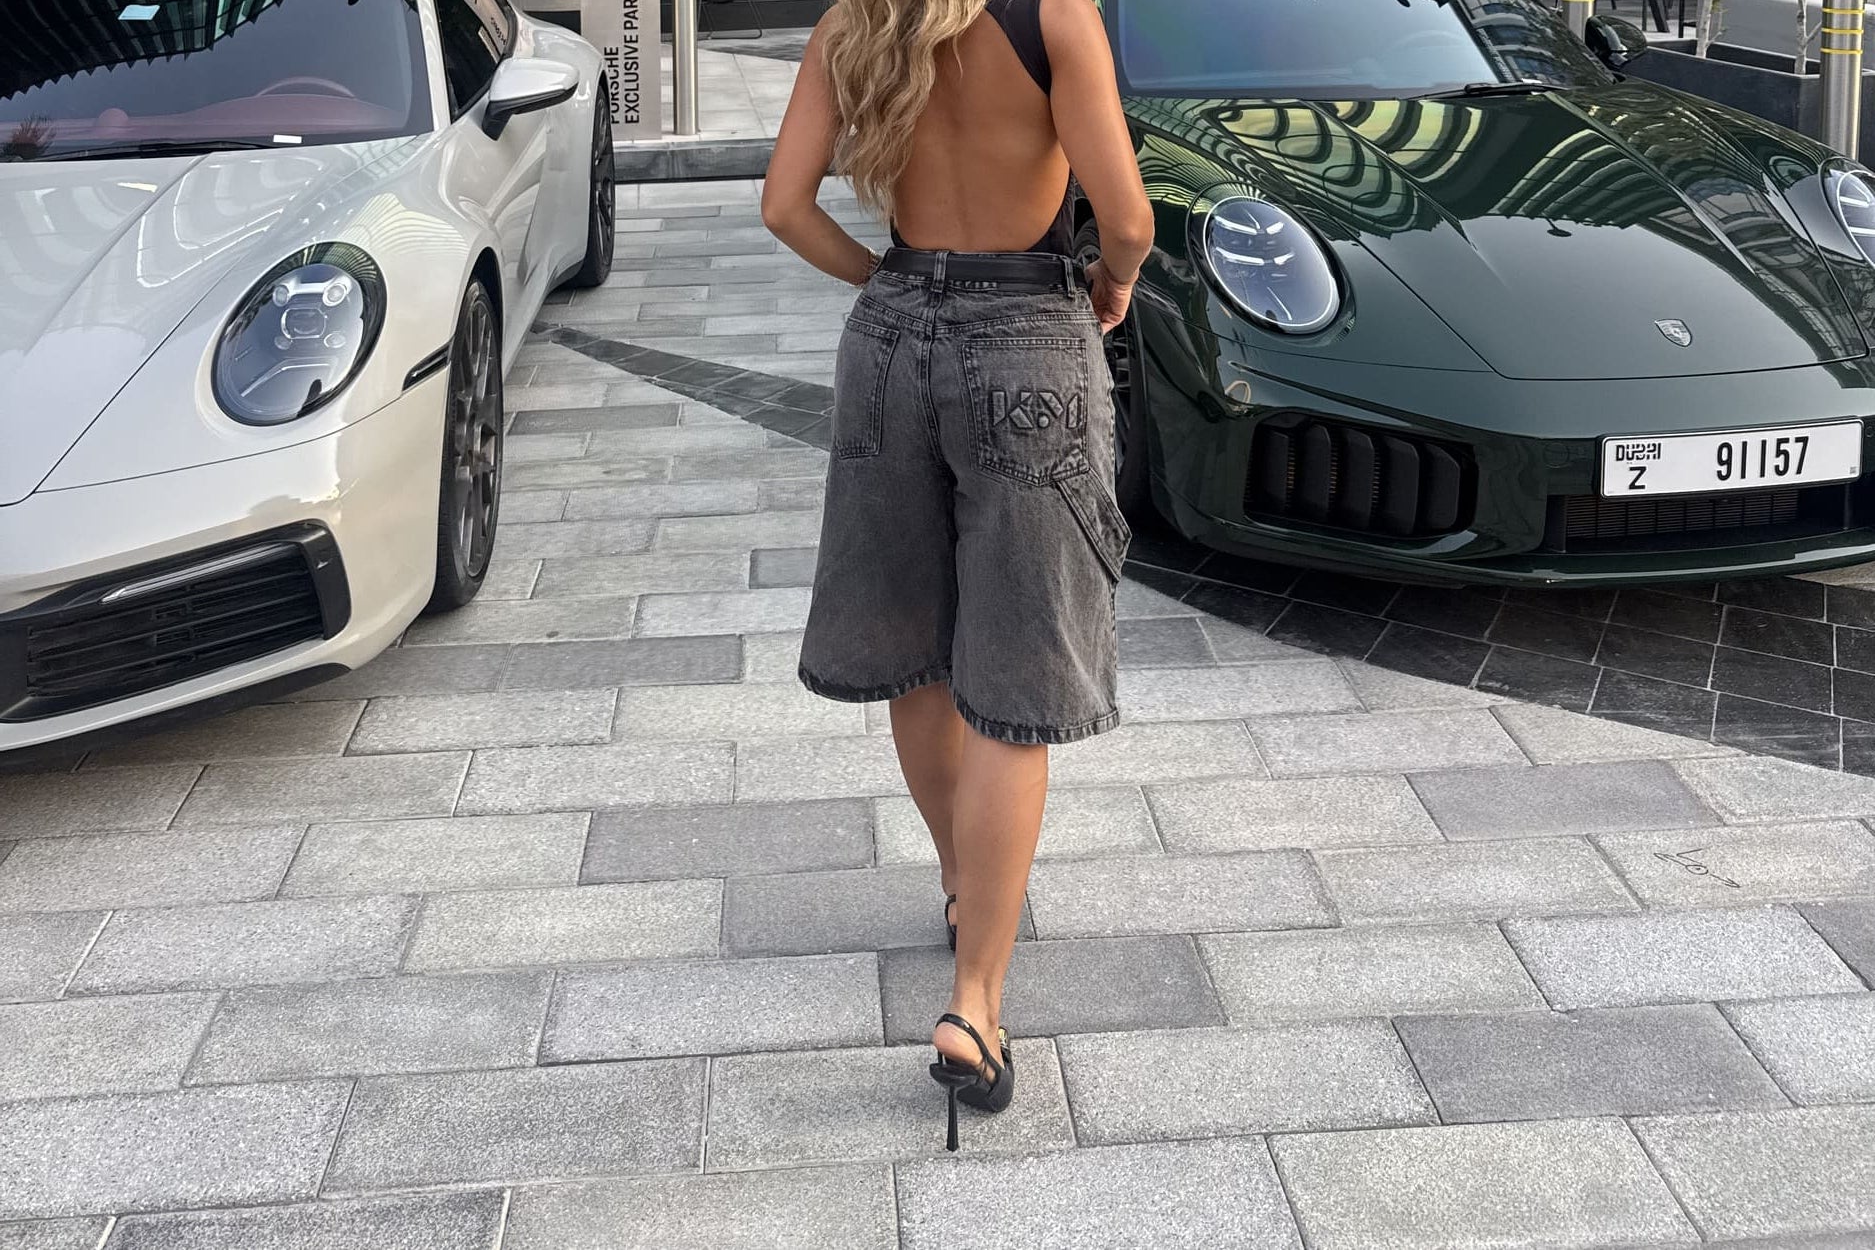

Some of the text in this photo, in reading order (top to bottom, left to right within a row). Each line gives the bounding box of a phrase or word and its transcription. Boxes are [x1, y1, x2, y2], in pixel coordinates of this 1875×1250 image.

[624, 34, 640, 124] EXCLUSIVE
[1616, 435, 1810, 481] DUBAI 91157
[1628, 466, 1647, 490] Z
